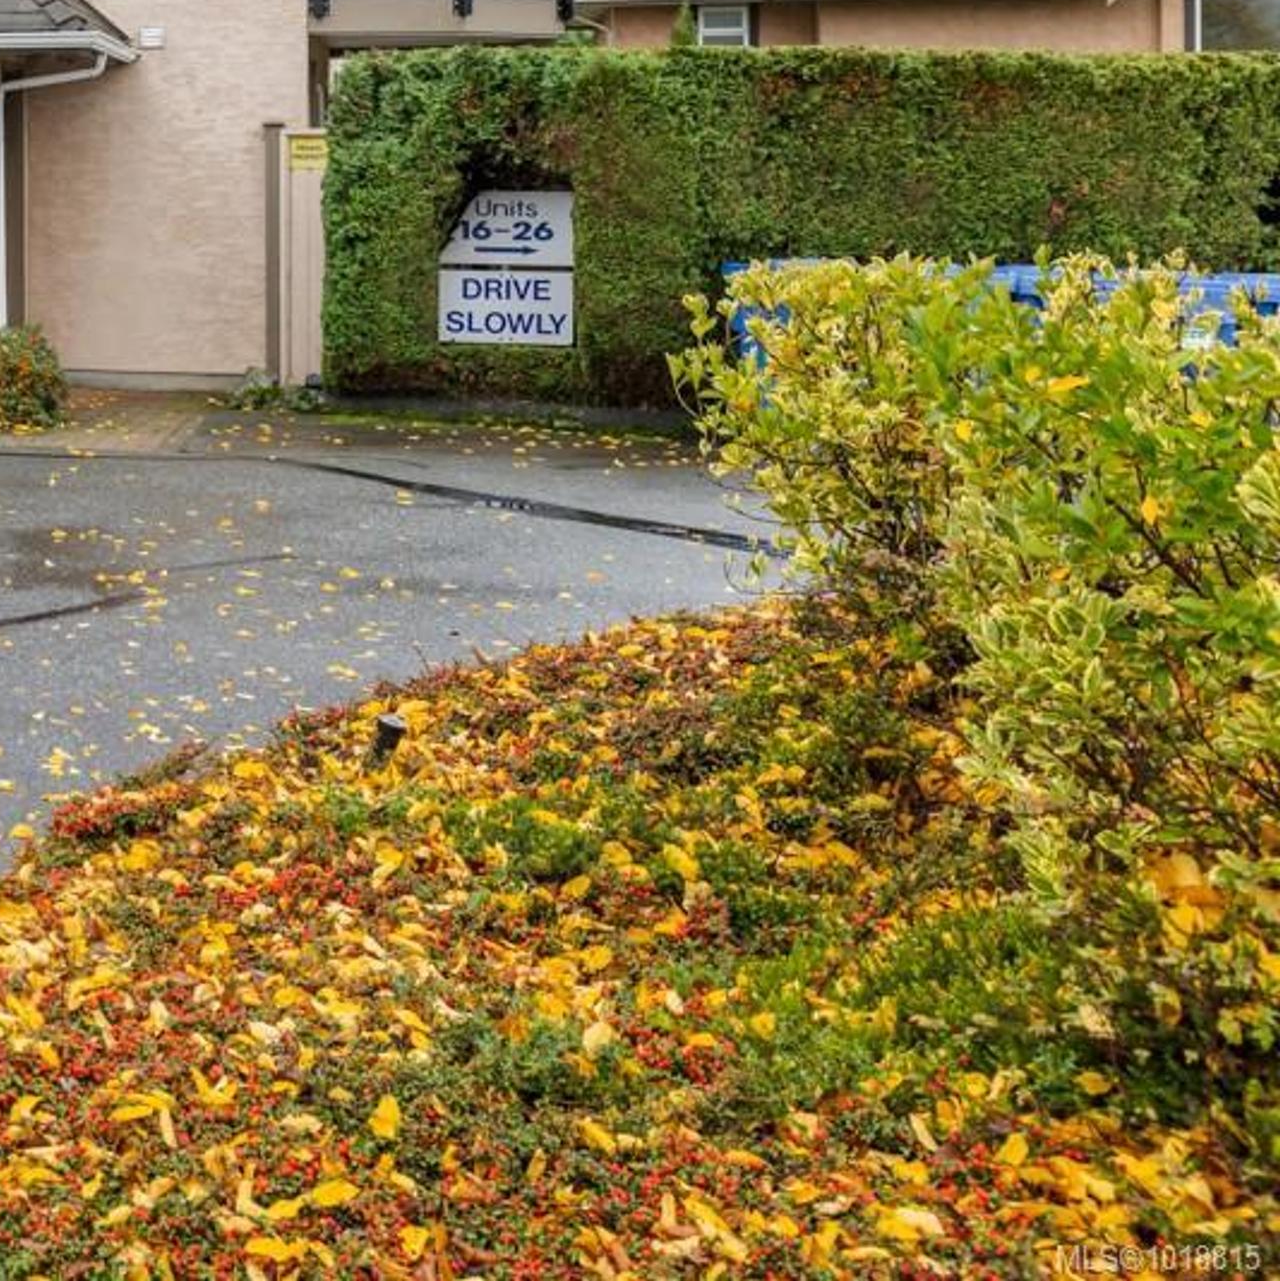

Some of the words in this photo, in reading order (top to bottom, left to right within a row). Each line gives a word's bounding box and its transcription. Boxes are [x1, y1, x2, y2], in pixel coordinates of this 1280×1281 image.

[475, 199, 538, 218] Units
[461, 221, 554, 241] 16-26
[462, 278, 551, 300] DRIVE
[446, 311, 567, 335] SLOWLY
